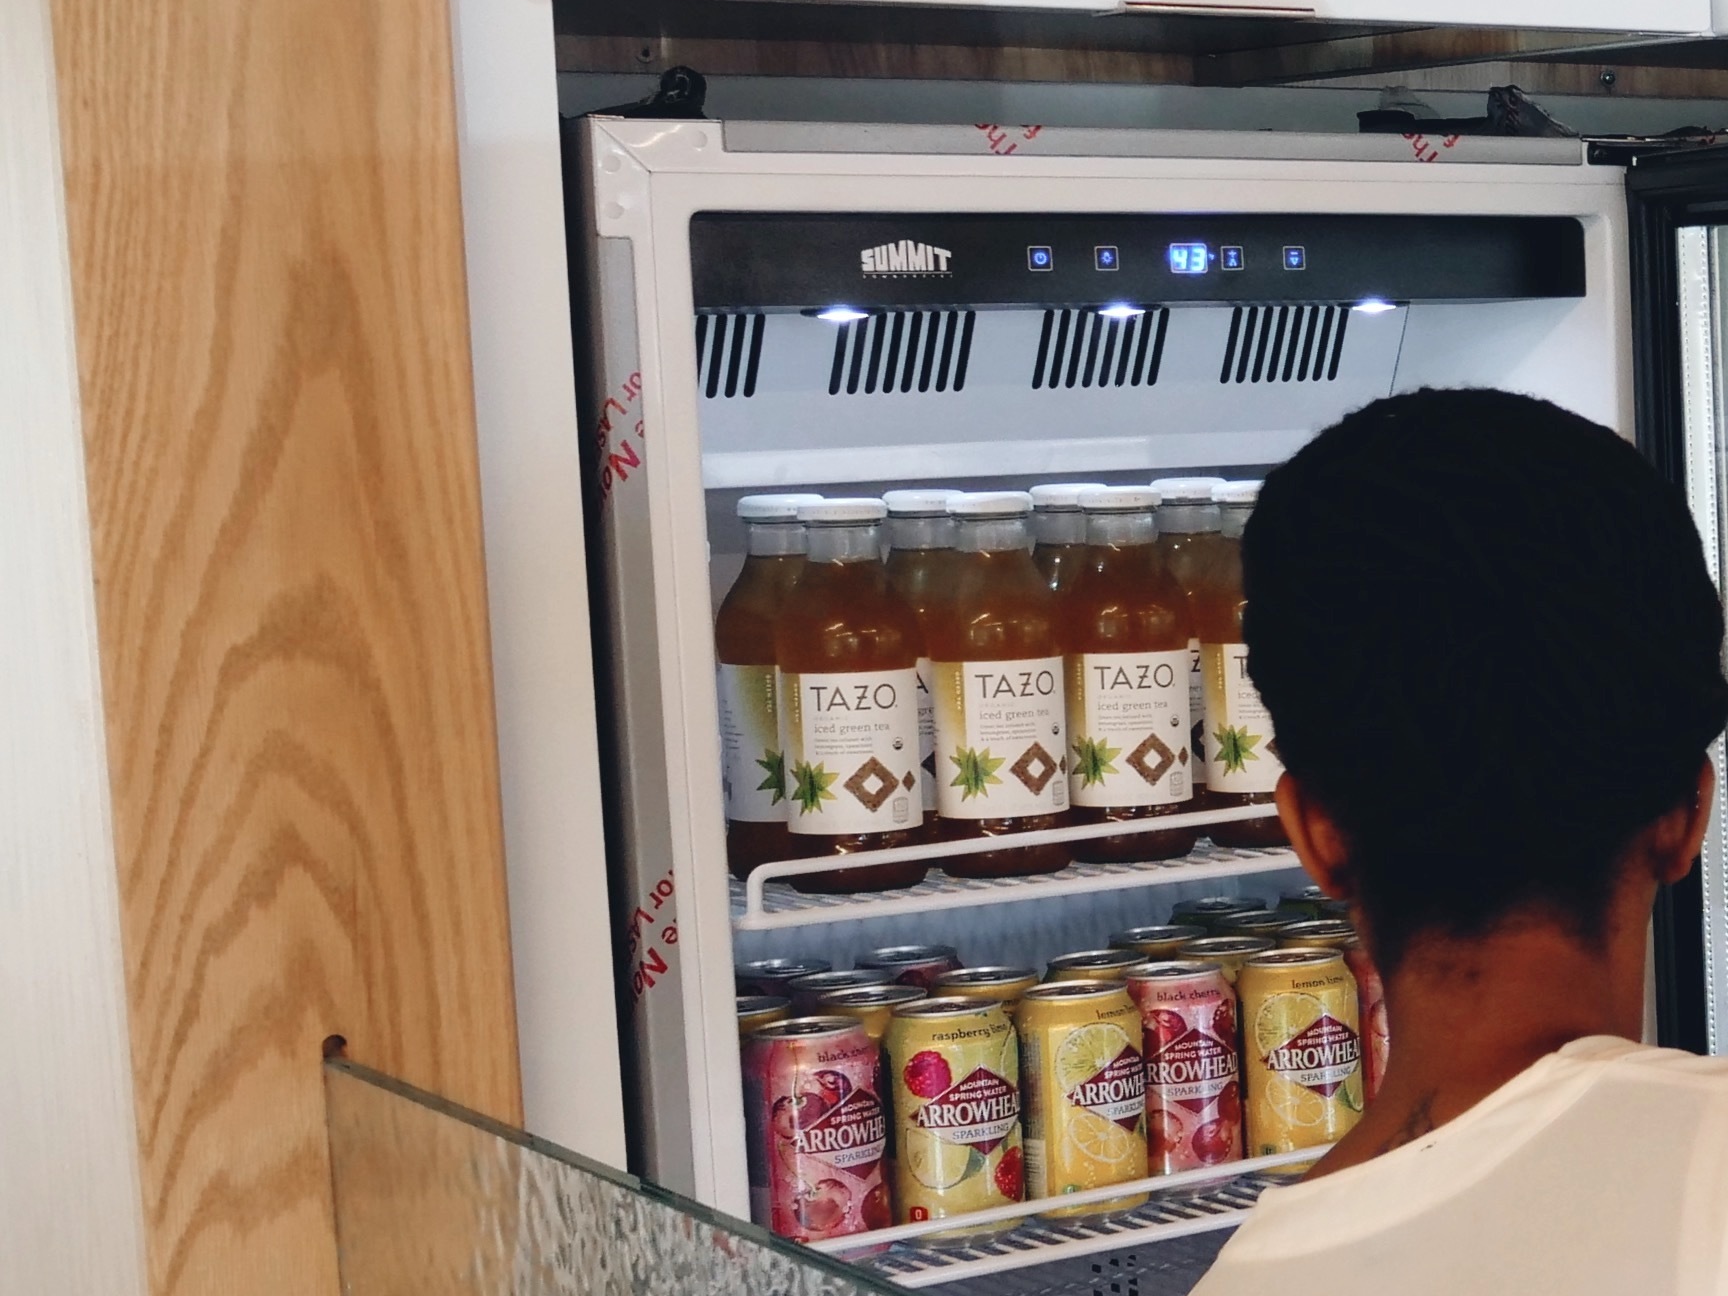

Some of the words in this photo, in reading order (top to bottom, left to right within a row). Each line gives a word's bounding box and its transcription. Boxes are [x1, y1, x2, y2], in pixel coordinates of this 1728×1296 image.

[861, 239, 952, 272] SUMMIT
[1172, 247, 1206, 271] 43
[974, 670, 1056, 699] TAZO
[1094, 663, 1175, 690] TAZO
[809, 683, 898, 711] TAZO
[980, 710, 1002, 720] iced
[1005, 708, 1034, 721] green
[1097, 702, 1119, 711] iced
[1122, 701, 1151, 712] green
[814, 724, 835, 734] iced
[839, 722, 871, 736] green
[874, 722, 890, 731] tea
[1292, 979, 1325, 989] lemon
[1157, 990, 1186, 1002] black
[932, 1026, 991, 1042] raspberry
[817, 1049, 847, 1064] black
[1165, 1050, 1196, 1060] SPRING
[1267, 1037, 1360, 1070] ARROWHEA
[1147, 1052, 1238, 1084] RROWHEAD
[949, 1091, 983, 1102] SPRING
[984, 1085, 1007, 1098] WATER
[960, 1079, 999, 1092] MOUNTAIN
[1072, 1072, 1144, 1107] ARROWH
[917, 1091, 1020, 1128] ARROWHEA
[830, 1113, 862, 1126] SPRING
[795, 1116, 886, 1153] ARROWHE
[953, 1122, 1009, 1140] SPARKLING
